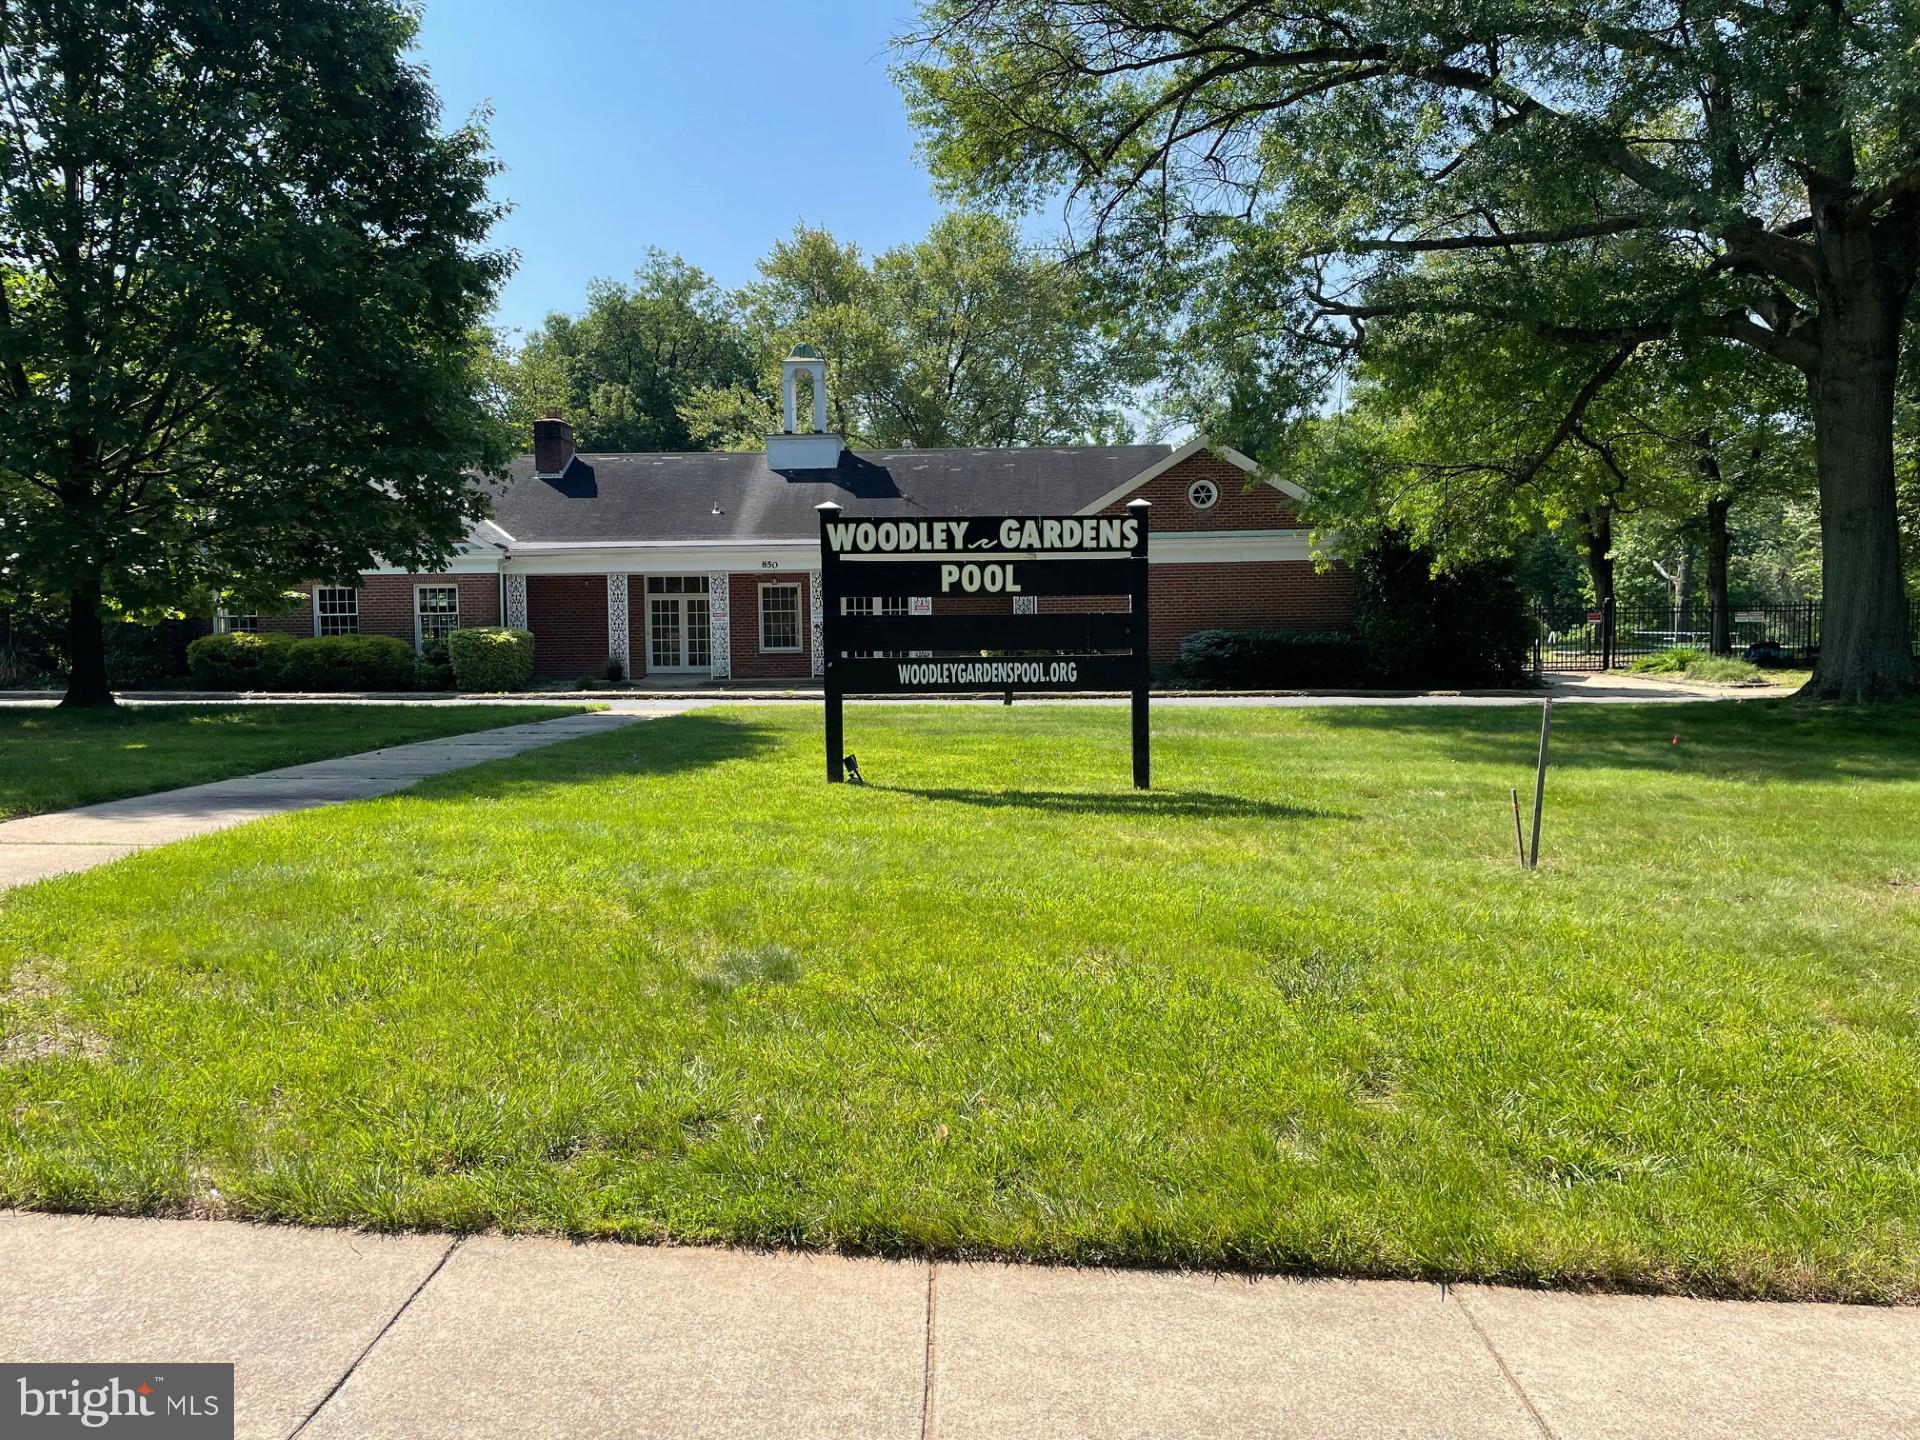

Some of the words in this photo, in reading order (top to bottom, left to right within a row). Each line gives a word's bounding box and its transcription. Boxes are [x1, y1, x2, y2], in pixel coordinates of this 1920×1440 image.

[826, 521, 969, 552] WOODLEY
[1000, 518, 1139, 549] GARDENS
[761, 560, 778, 569] 850
[941, 564, 1021, 592] POOL
[898, 662, 1077, 685] WOODLEYGARDENSPOOL.ORG
